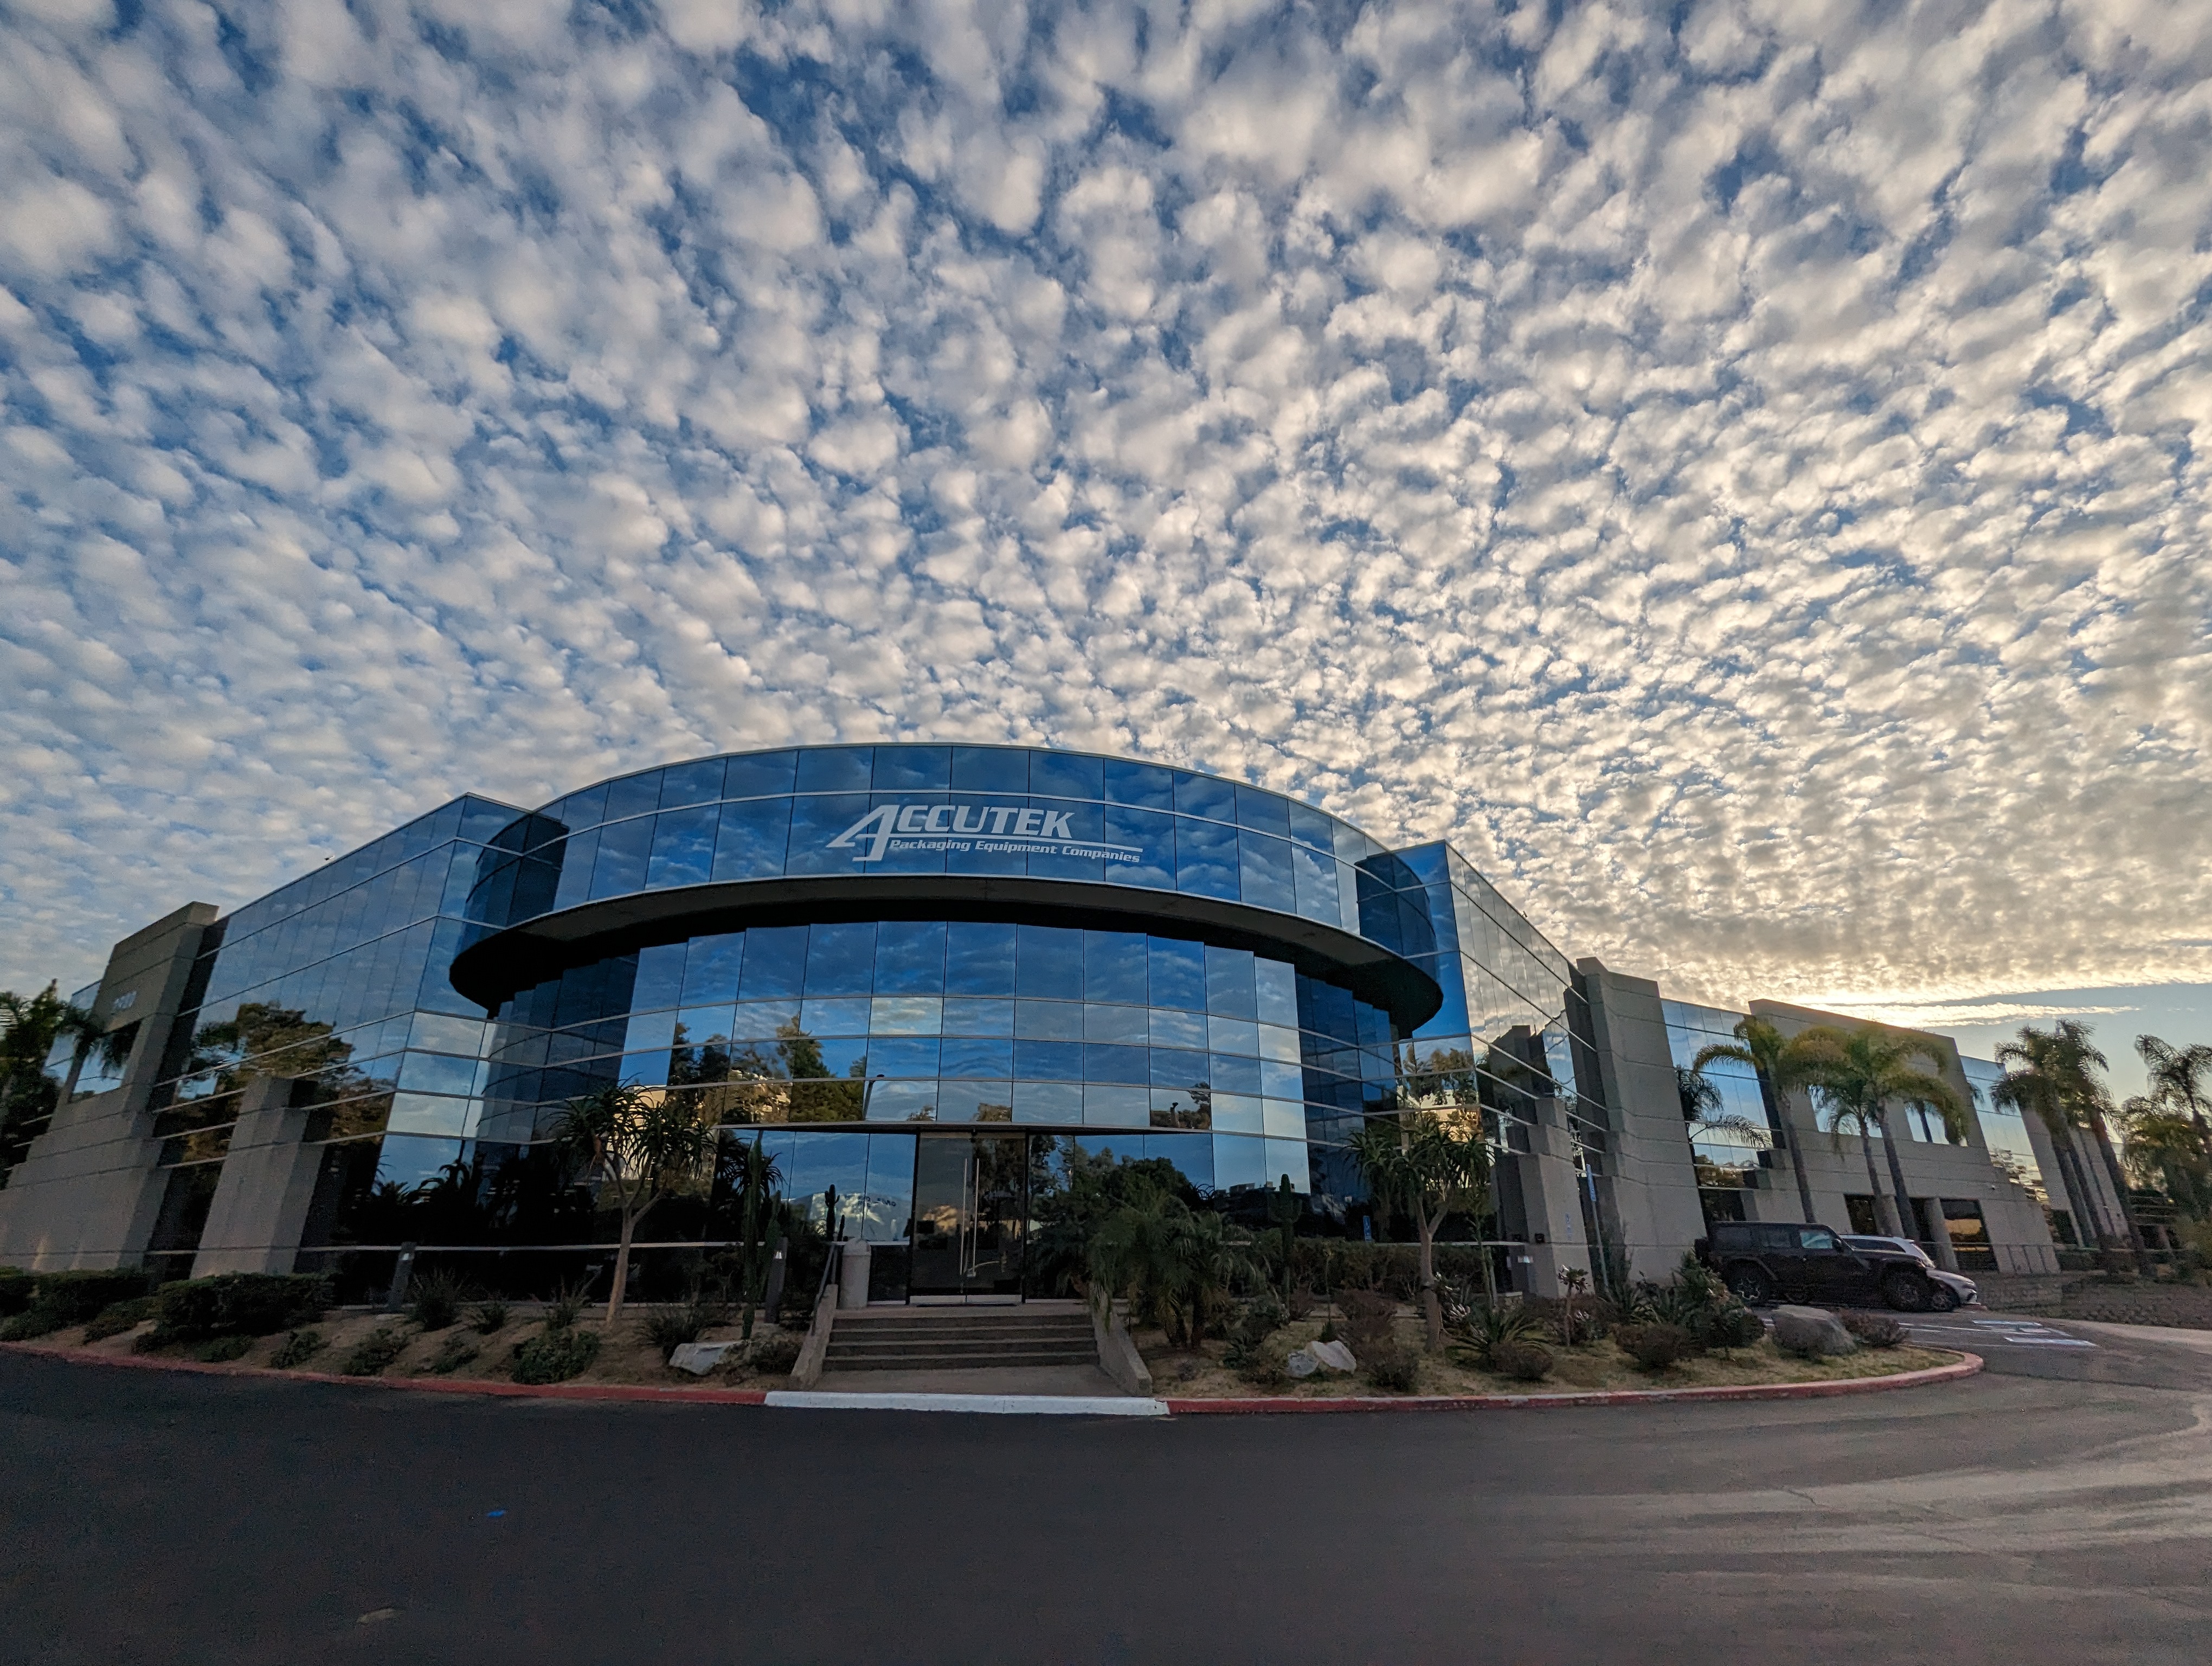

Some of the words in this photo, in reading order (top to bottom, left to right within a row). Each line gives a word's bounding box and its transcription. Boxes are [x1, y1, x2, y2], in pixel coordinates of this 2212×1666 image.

[826, 805, 1075, 861] ACCUTEK
[889, 840, 972, 852] Packaging
[975, 841, 1058, 854] Equipment
[1062, 845, 1140, 862] Companies
